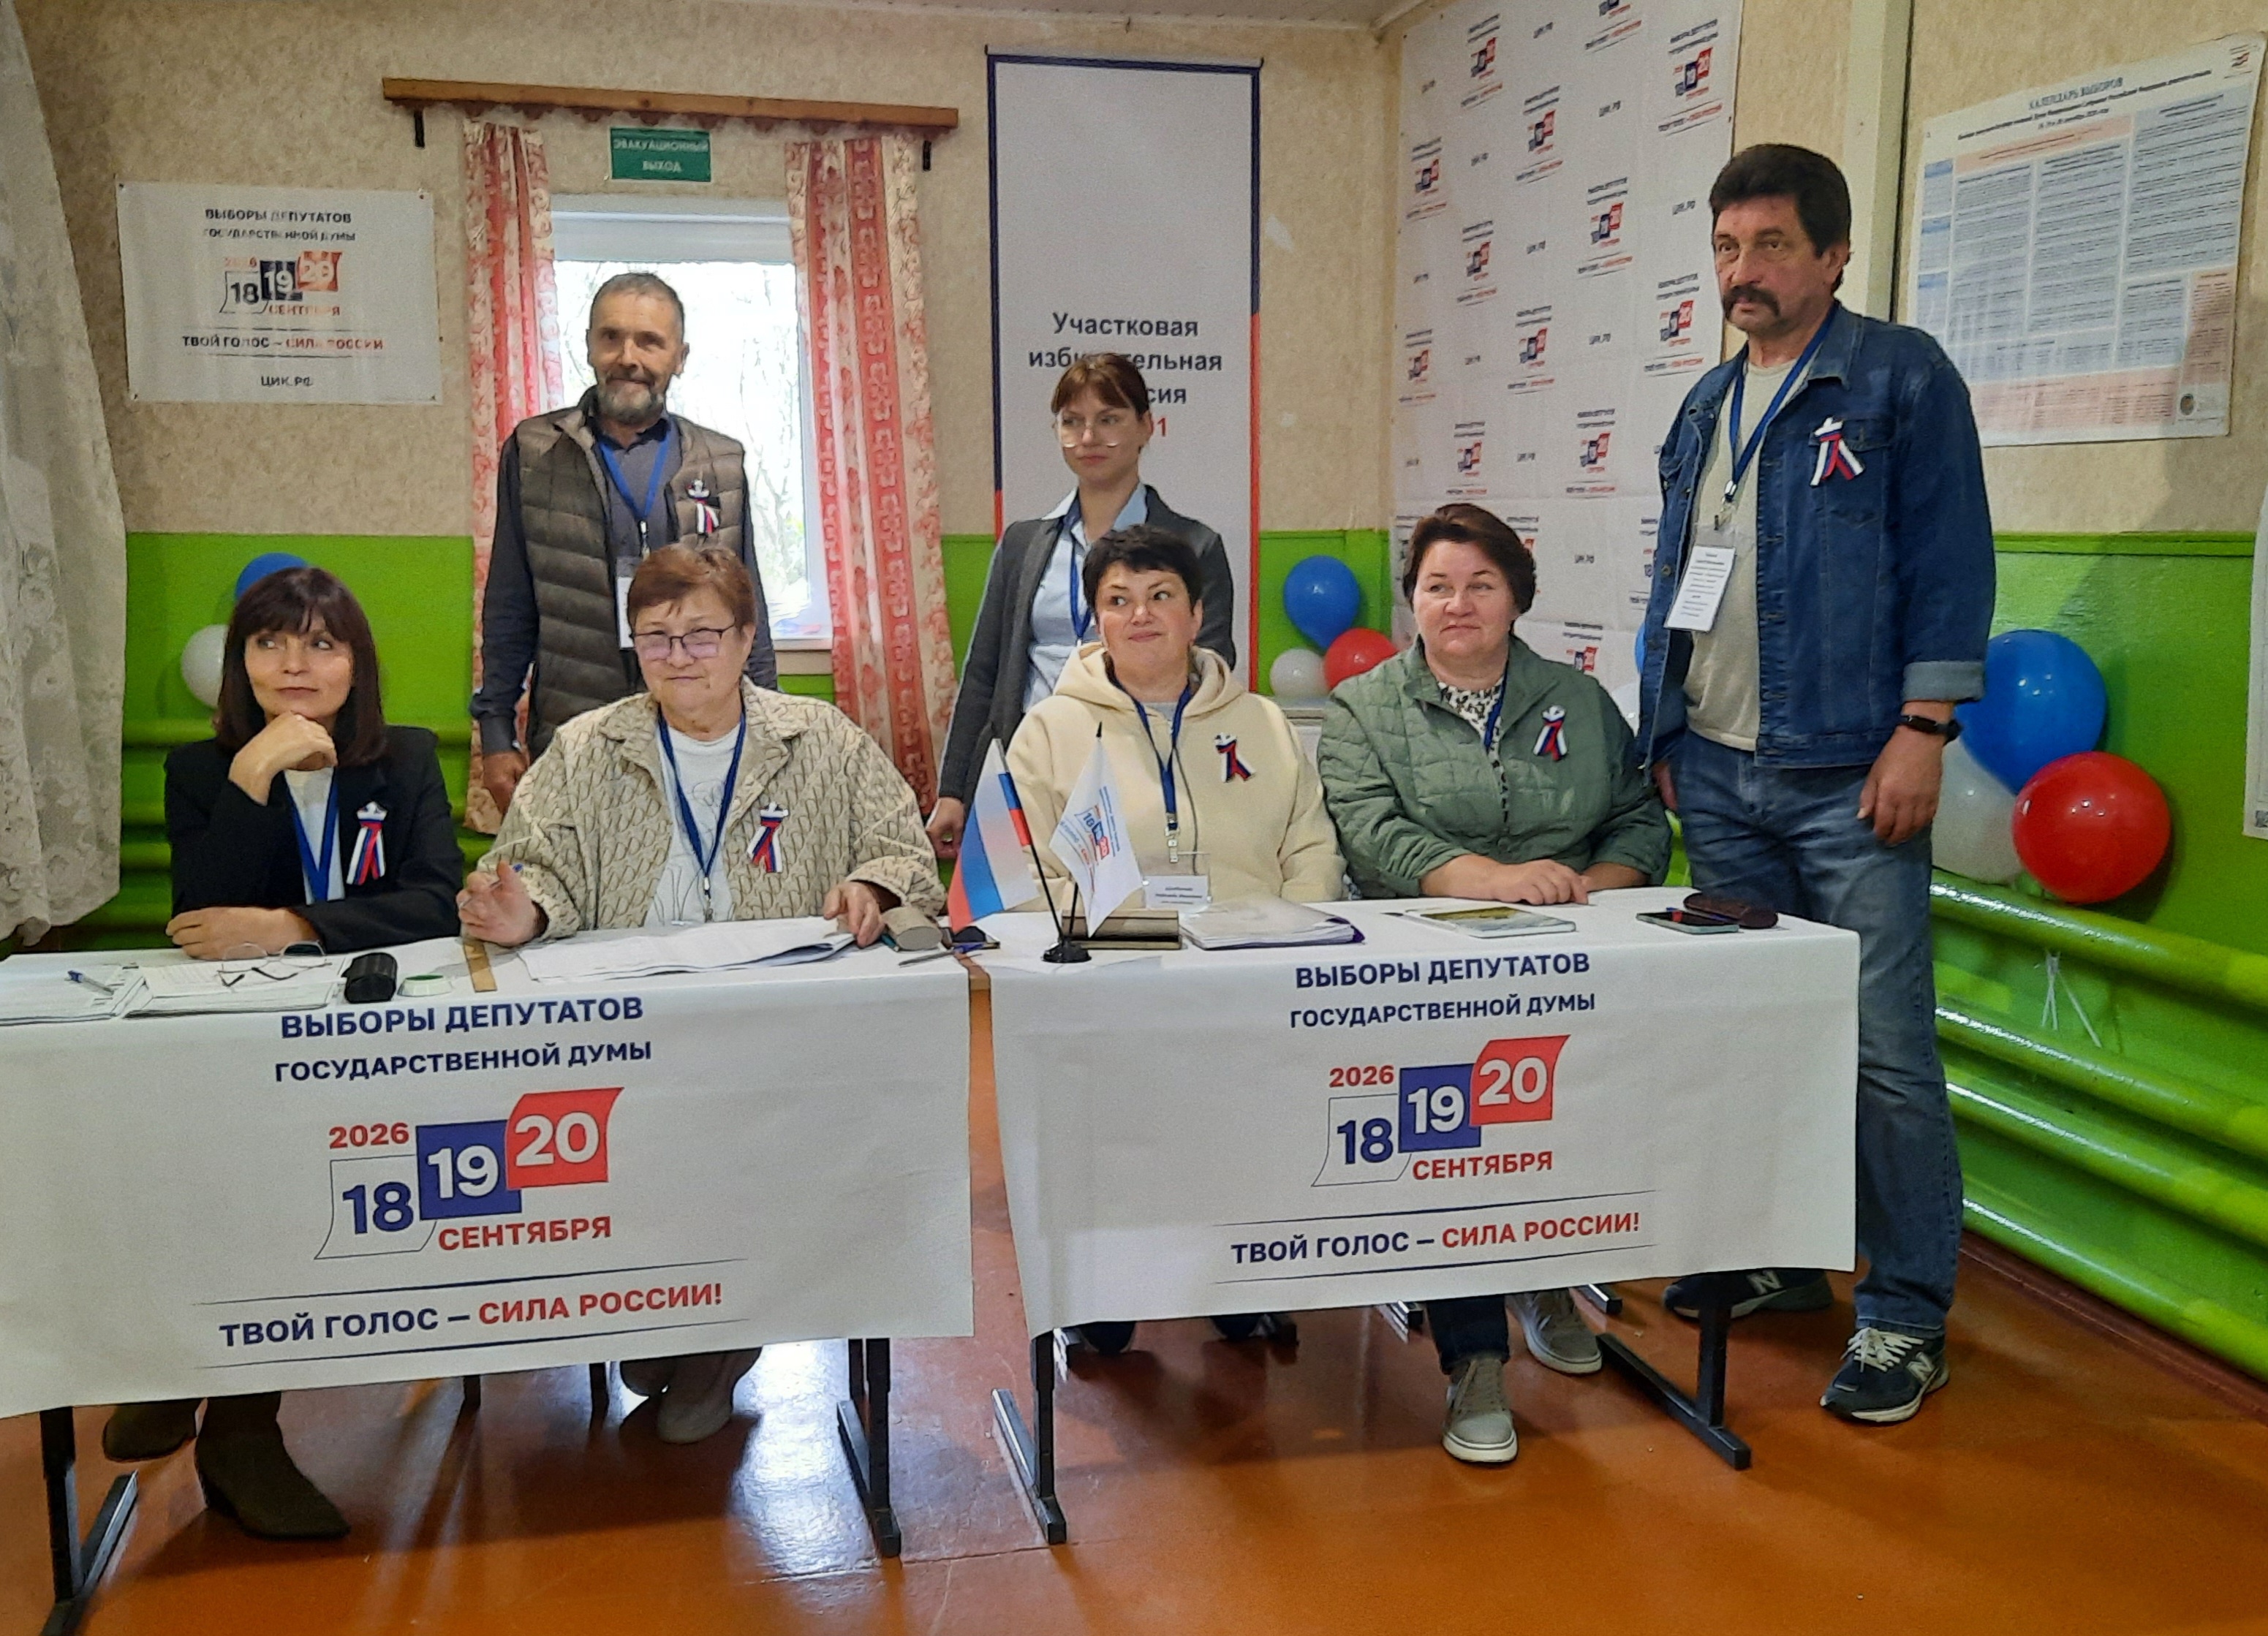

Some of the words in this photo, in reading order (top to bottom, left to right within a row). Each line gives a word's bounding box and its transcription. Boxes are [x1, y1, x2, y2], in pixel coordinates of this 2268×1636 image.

[205, 208, 268, 220] ВЫБОРЫ
[230, 282, 260, 305] 18
[263, 270, 293, 293] 19
[299, 260, 335, 283] 20
[1051, 311, 1199, 336] Участковая
[182, 336, 219, 348] ТВОЙ
[1295, 962, 1421, 989] ВЫБОРЫ
[1428, 953, 1590, 984] ДЕПУТАТОВ
[281, 1007, 435, 1038] ВЫБОРЫ
[445, 997, 643, 1032] ДЕПУТАТОВ
[1290, 993, 1521, 1028] ГОСУДАРСТВЕННОЙ
[1526, 993, 1595, 1015] ДУМЫ
[276, 1043, 560, 1082] ГОСУДАРСТВЕННОЙ
[567, 1041, 651, 1067] ДУМЫ
[1329, 1065, 1394, 1088] 2026
[1337, 1118, 1393, 1165] 18
[1407, 1085, 1464, 1135] 19
[1478, 1056, 1548, 1106] 20
[329, 1123, 409, 1148] 2026
[342, 1182, 413, 1235] 18
[428, 1145, 499, 1199] 19
[515, 1111, 600, 1167] 20
[1413, 1151, 1553, 1181] СЕНТЯБРЯ
[439, 1216, 611, 1251] СЕНТЯБРЯ
[1231, 1235, 1307, 1264] ТВОЙ
[1317, 1232, 1410, 1257] ГОЛОС
[1442, 1224, 1516, 1248] СИЛА
[1524, 1213, 1639, 1242] РОССИИ!
[219, 1313, 314, 1347] ТВОЙ
[325, 1307, 438, 1338] ГОЛОС
[479, 1296, 570, 1325] СИЛА
[579, 1283, 722, 1316] РОССИИ!
